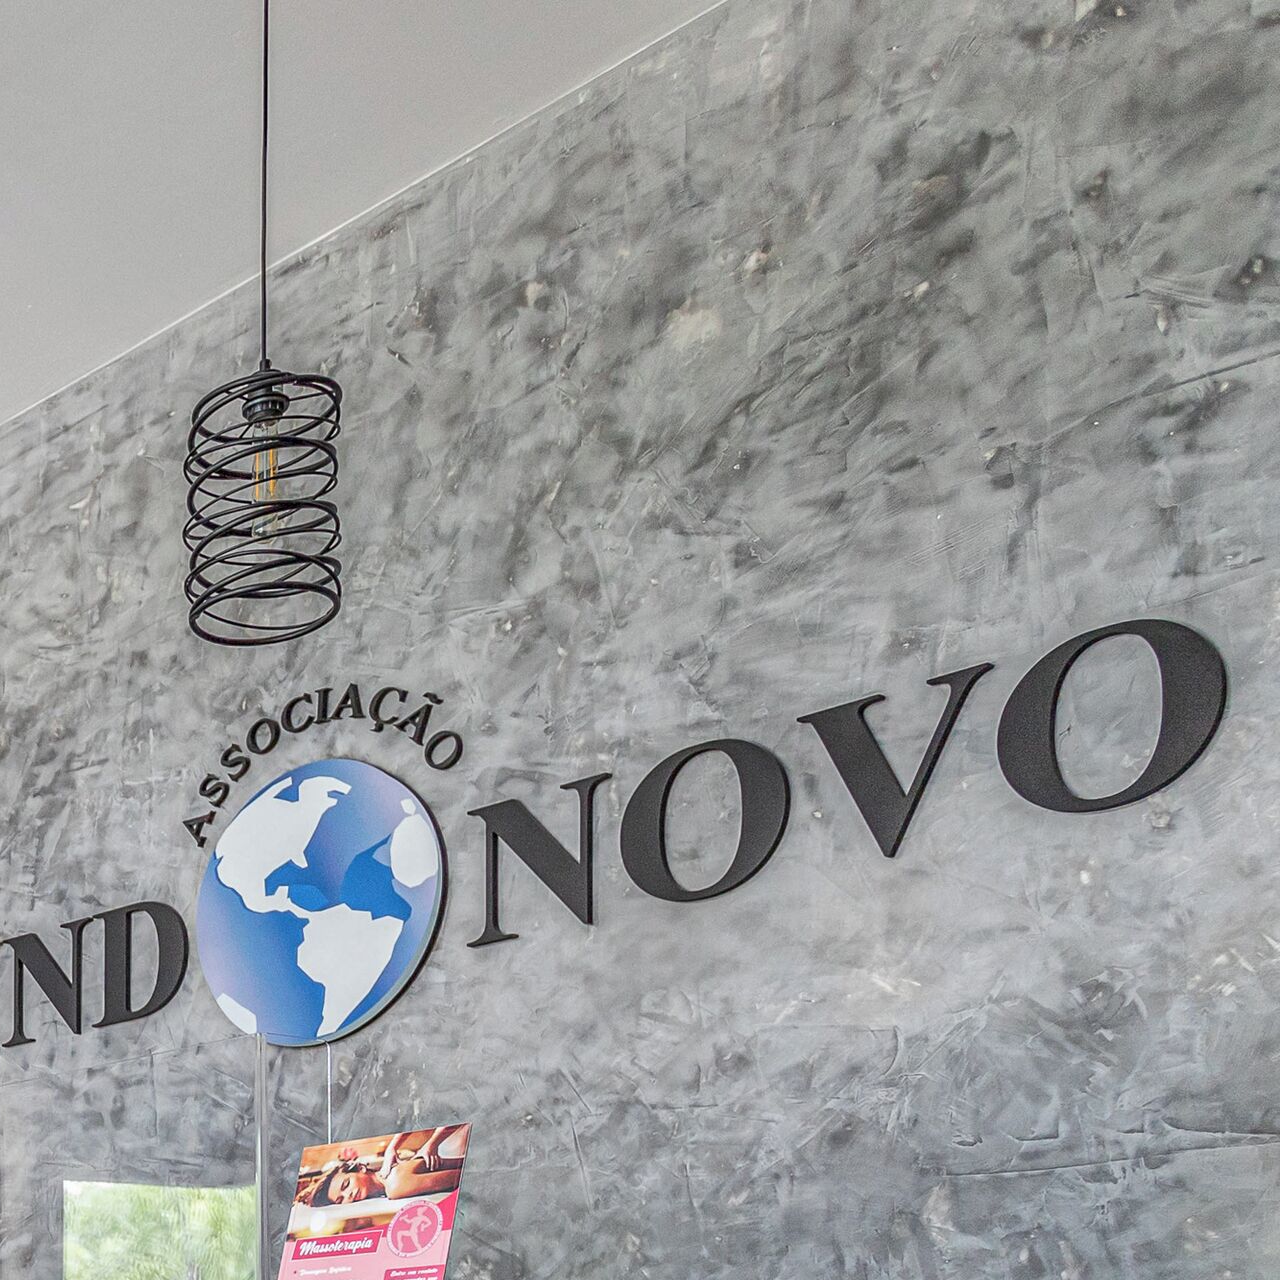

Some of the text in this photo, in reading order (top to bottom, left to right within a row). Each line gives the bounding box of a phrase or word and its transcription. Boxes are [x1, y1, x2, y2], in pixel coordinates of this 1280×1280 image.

[182, 683, 463, 848] ASSOCIAÇÃO
[467, 618, 1227, 948] NOVO
[299, 1237, 373, 1256] Massoterapia
